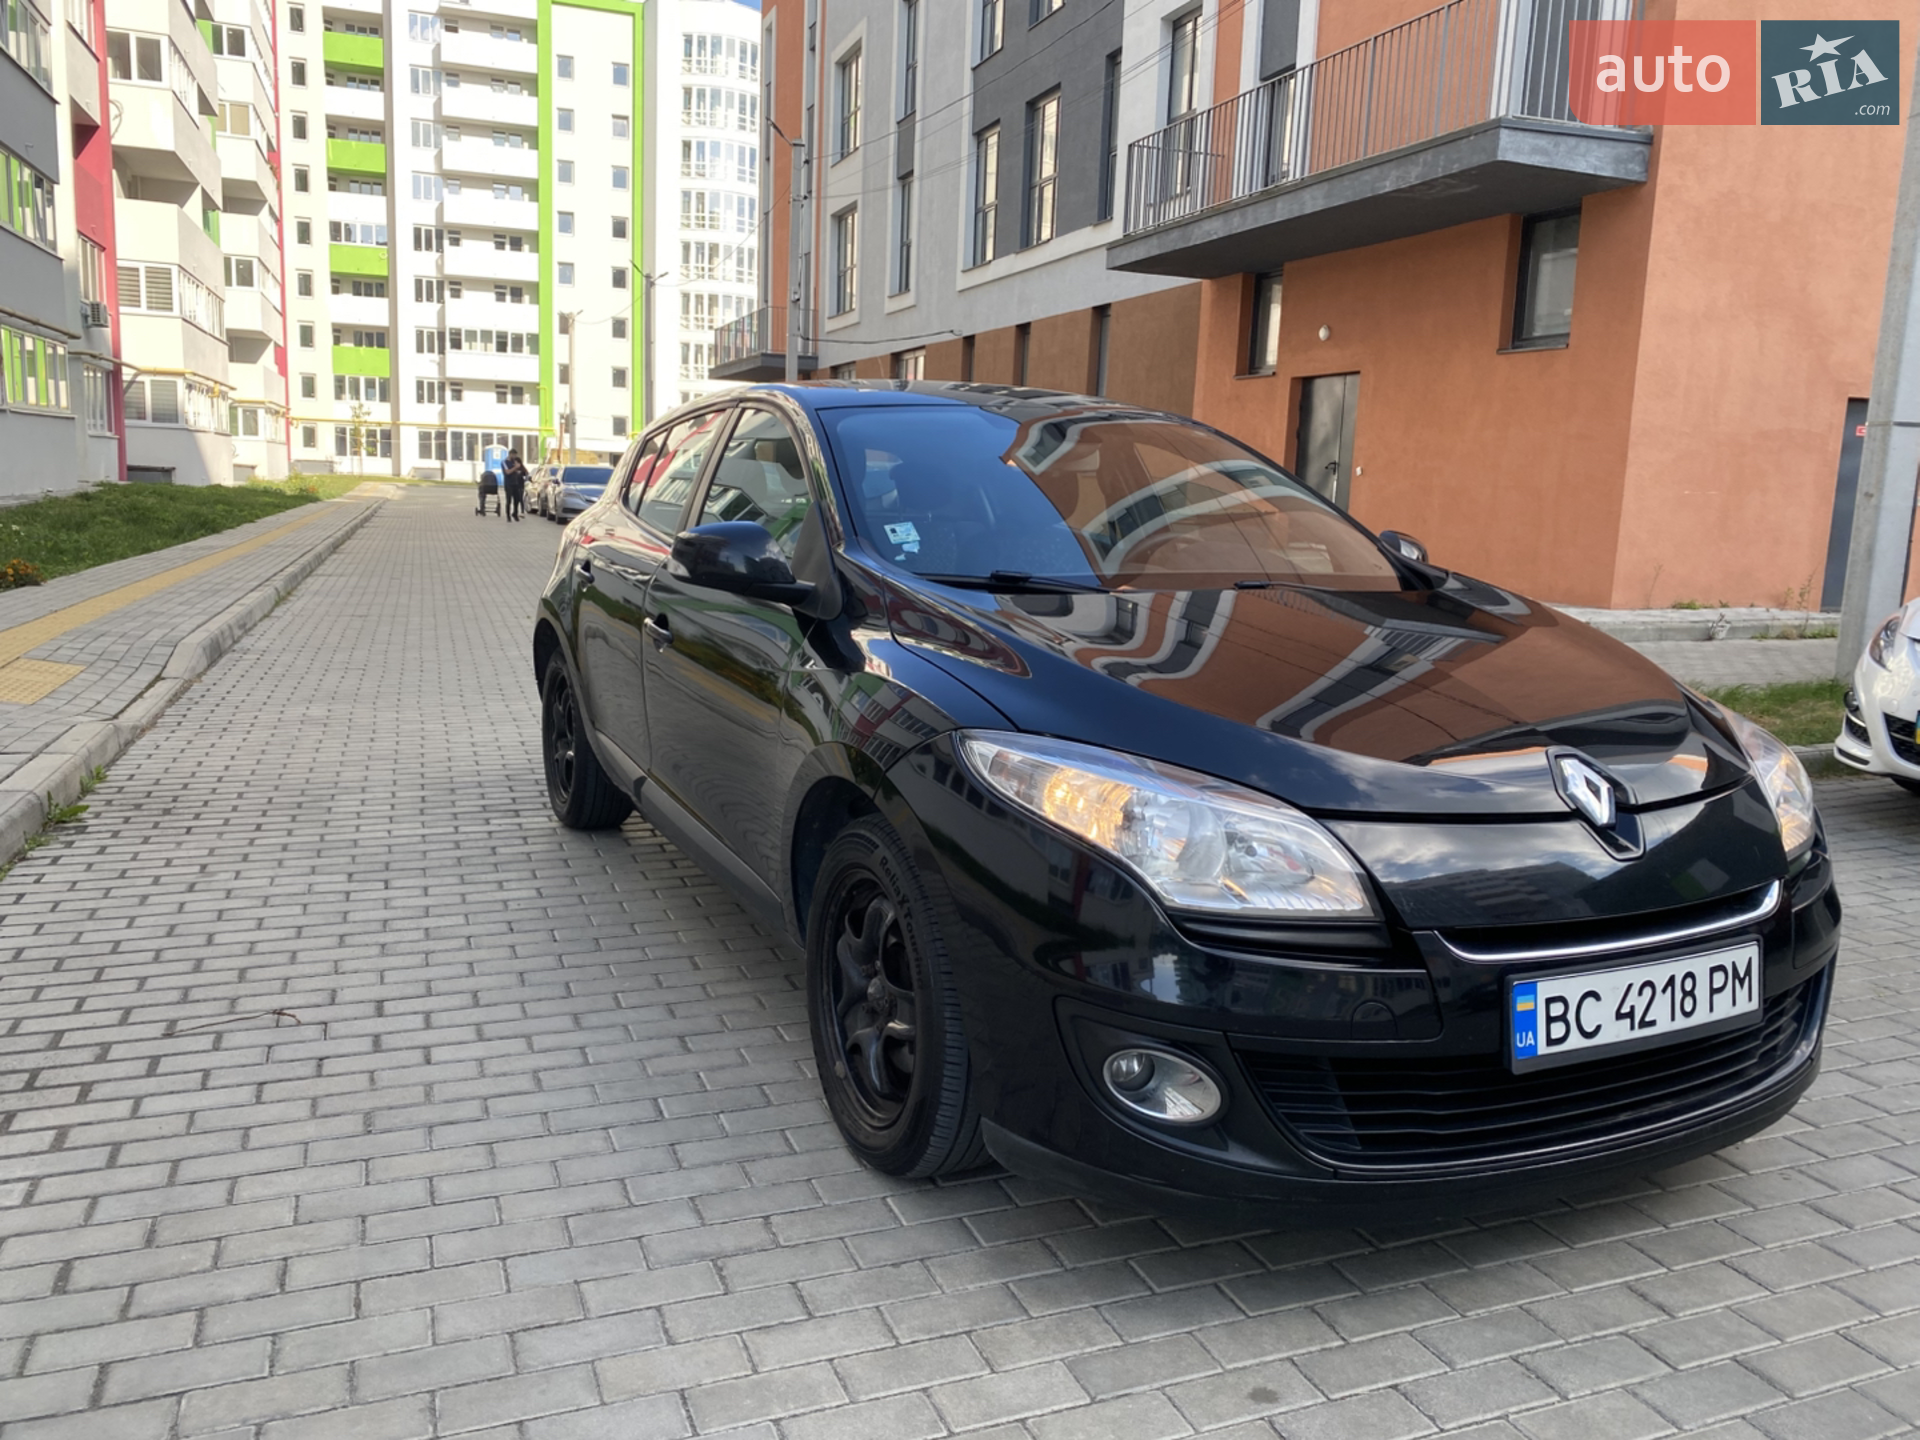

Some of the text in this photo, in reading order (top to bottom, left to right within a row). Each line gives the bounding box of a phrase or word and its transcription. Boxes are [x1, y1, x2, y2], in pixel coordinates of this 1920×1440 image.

[1544, 956, 1753, 1048] BC 4218 PM
[1516, 1030, 1536, 1049] UA
